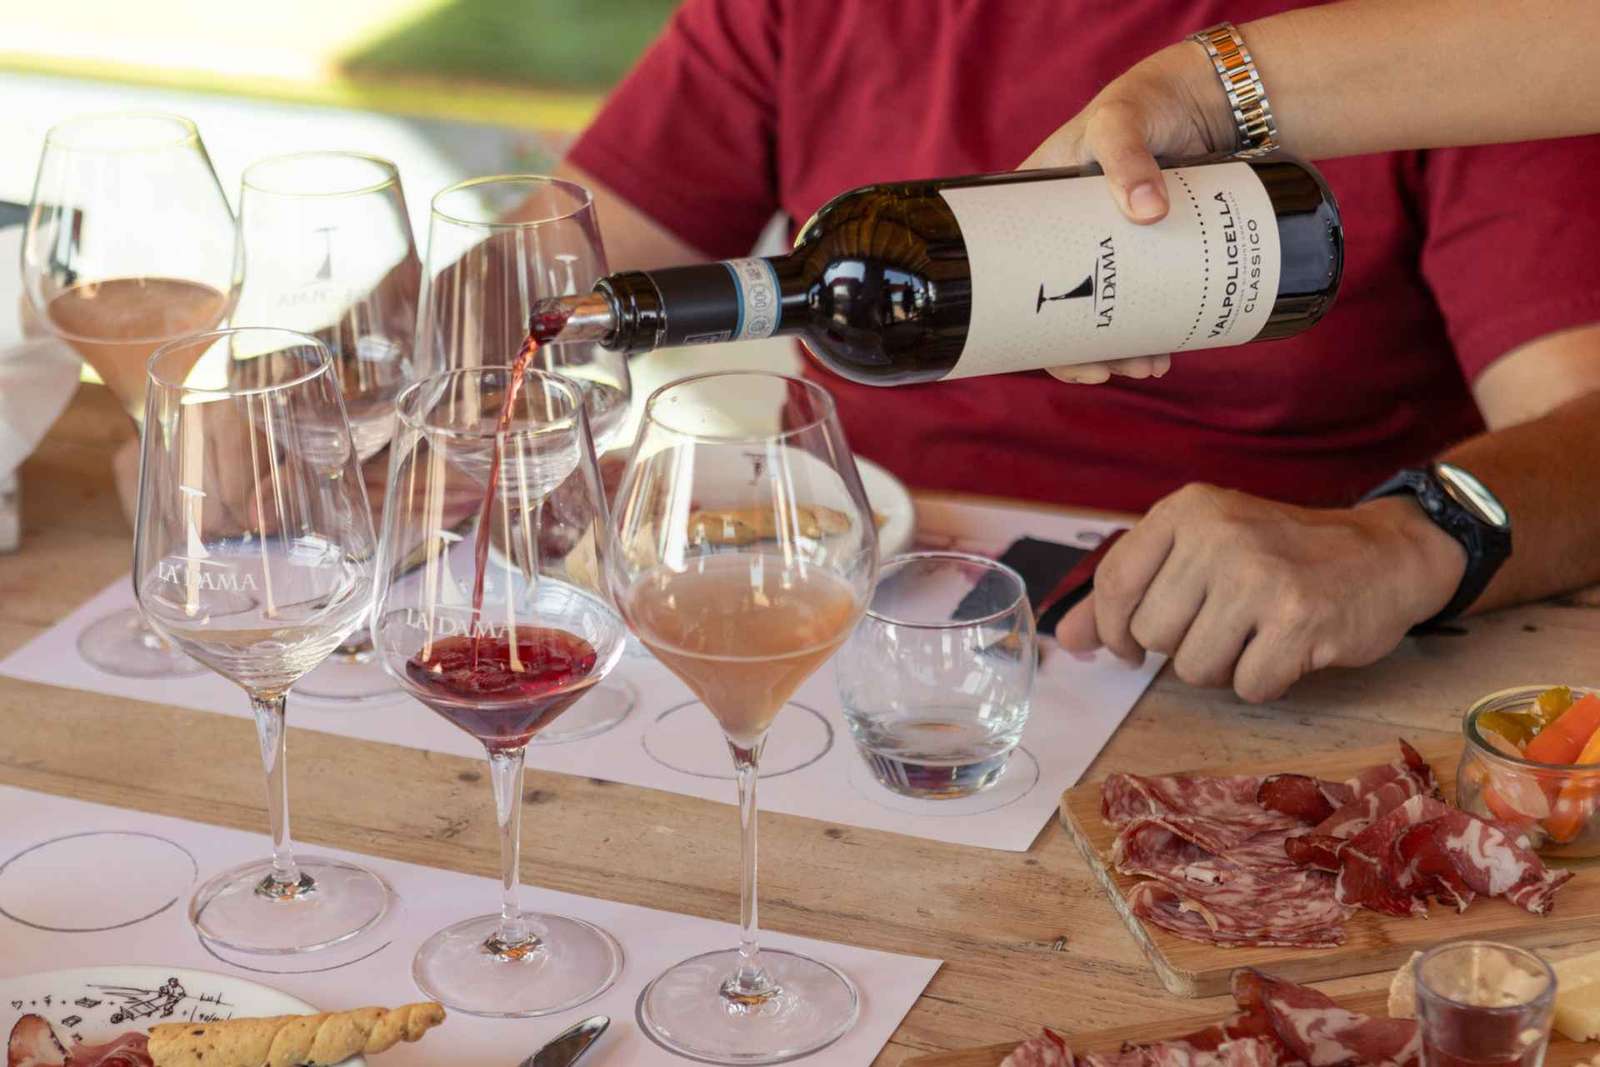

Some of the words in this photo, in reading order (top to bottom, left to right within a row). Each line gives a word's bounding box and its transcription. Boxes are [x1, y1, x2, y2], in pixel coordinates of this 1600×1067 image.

[1099, 236, 1116, 300] DAMA
[1208, 191, 1239, 338] VALPOLICELLA
[1243, 219, 1261, 313] CLASSICO
[1096, 306, 1114, 328] LA
[158, 561, 178, 584] LA
[406, 607, 429, 631] LA
